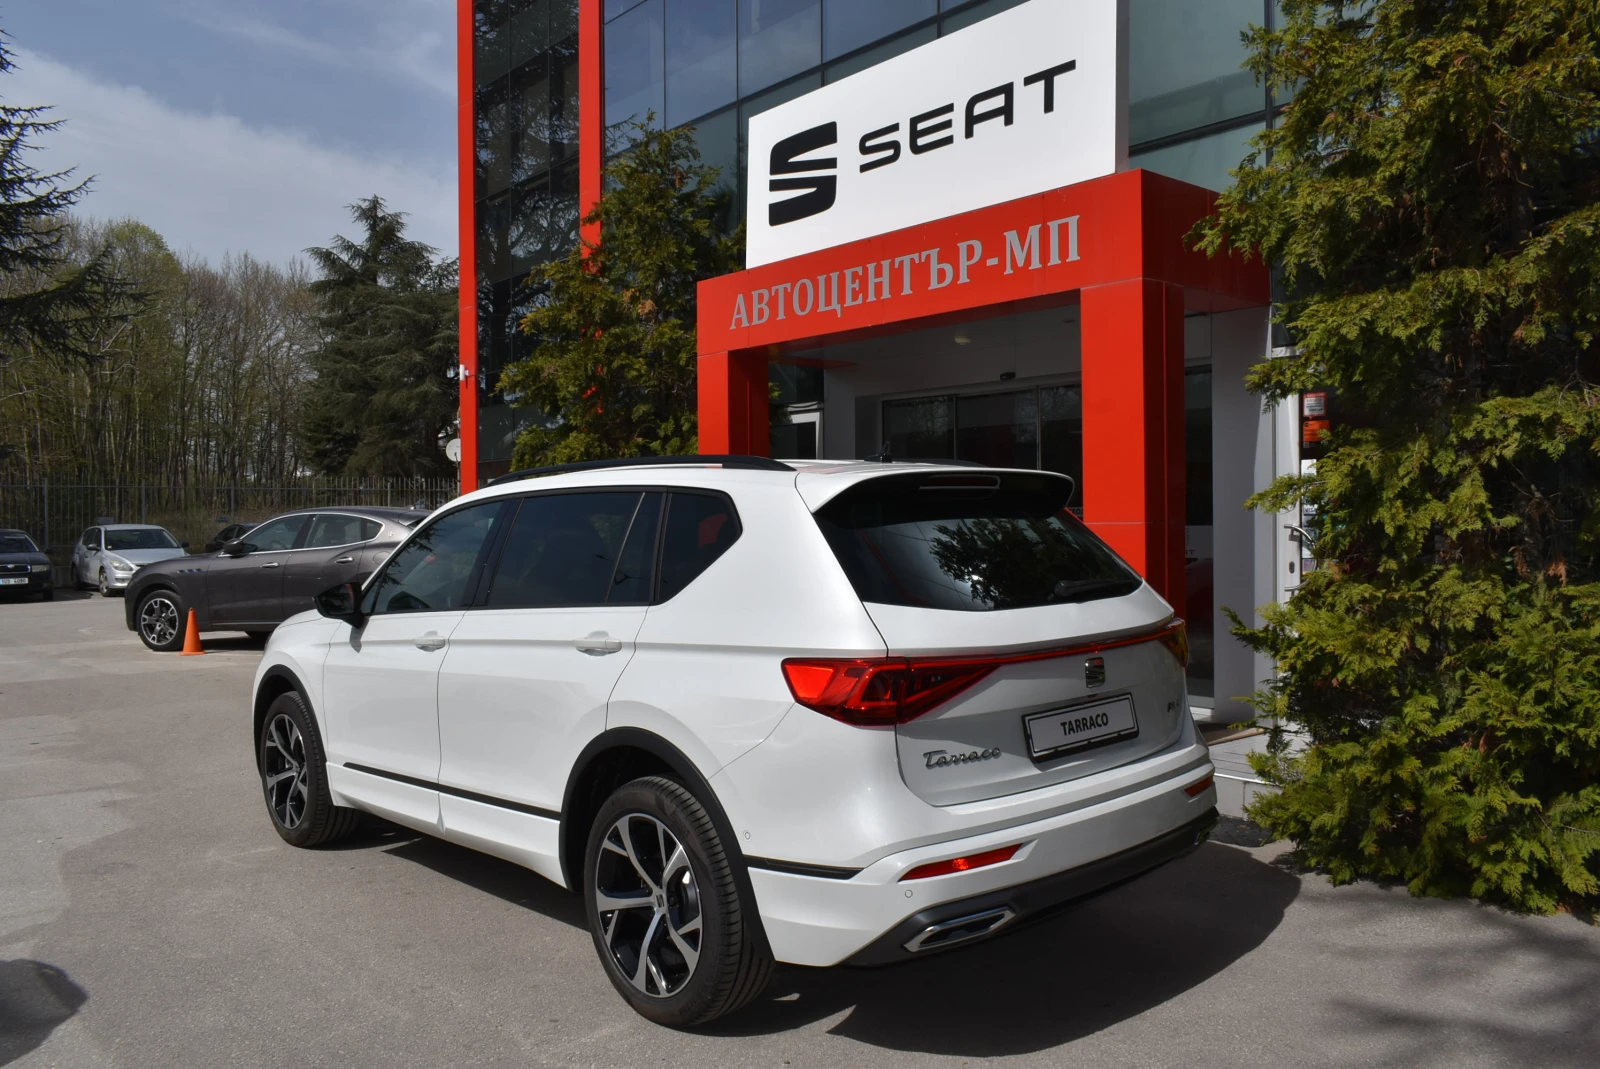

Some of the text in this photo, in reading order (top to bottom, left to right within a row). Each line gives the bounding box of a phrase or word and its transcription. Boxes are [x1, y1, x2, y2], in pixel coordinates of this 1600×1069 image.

[859, 59, 1076, 173] SEAT
[729, 215, 1081, 330] АВТОЦЕНТЪР-МП
[923, 747, 1002, 770] Tarraco
[1060, 712, 1109, 736] TARRACO
